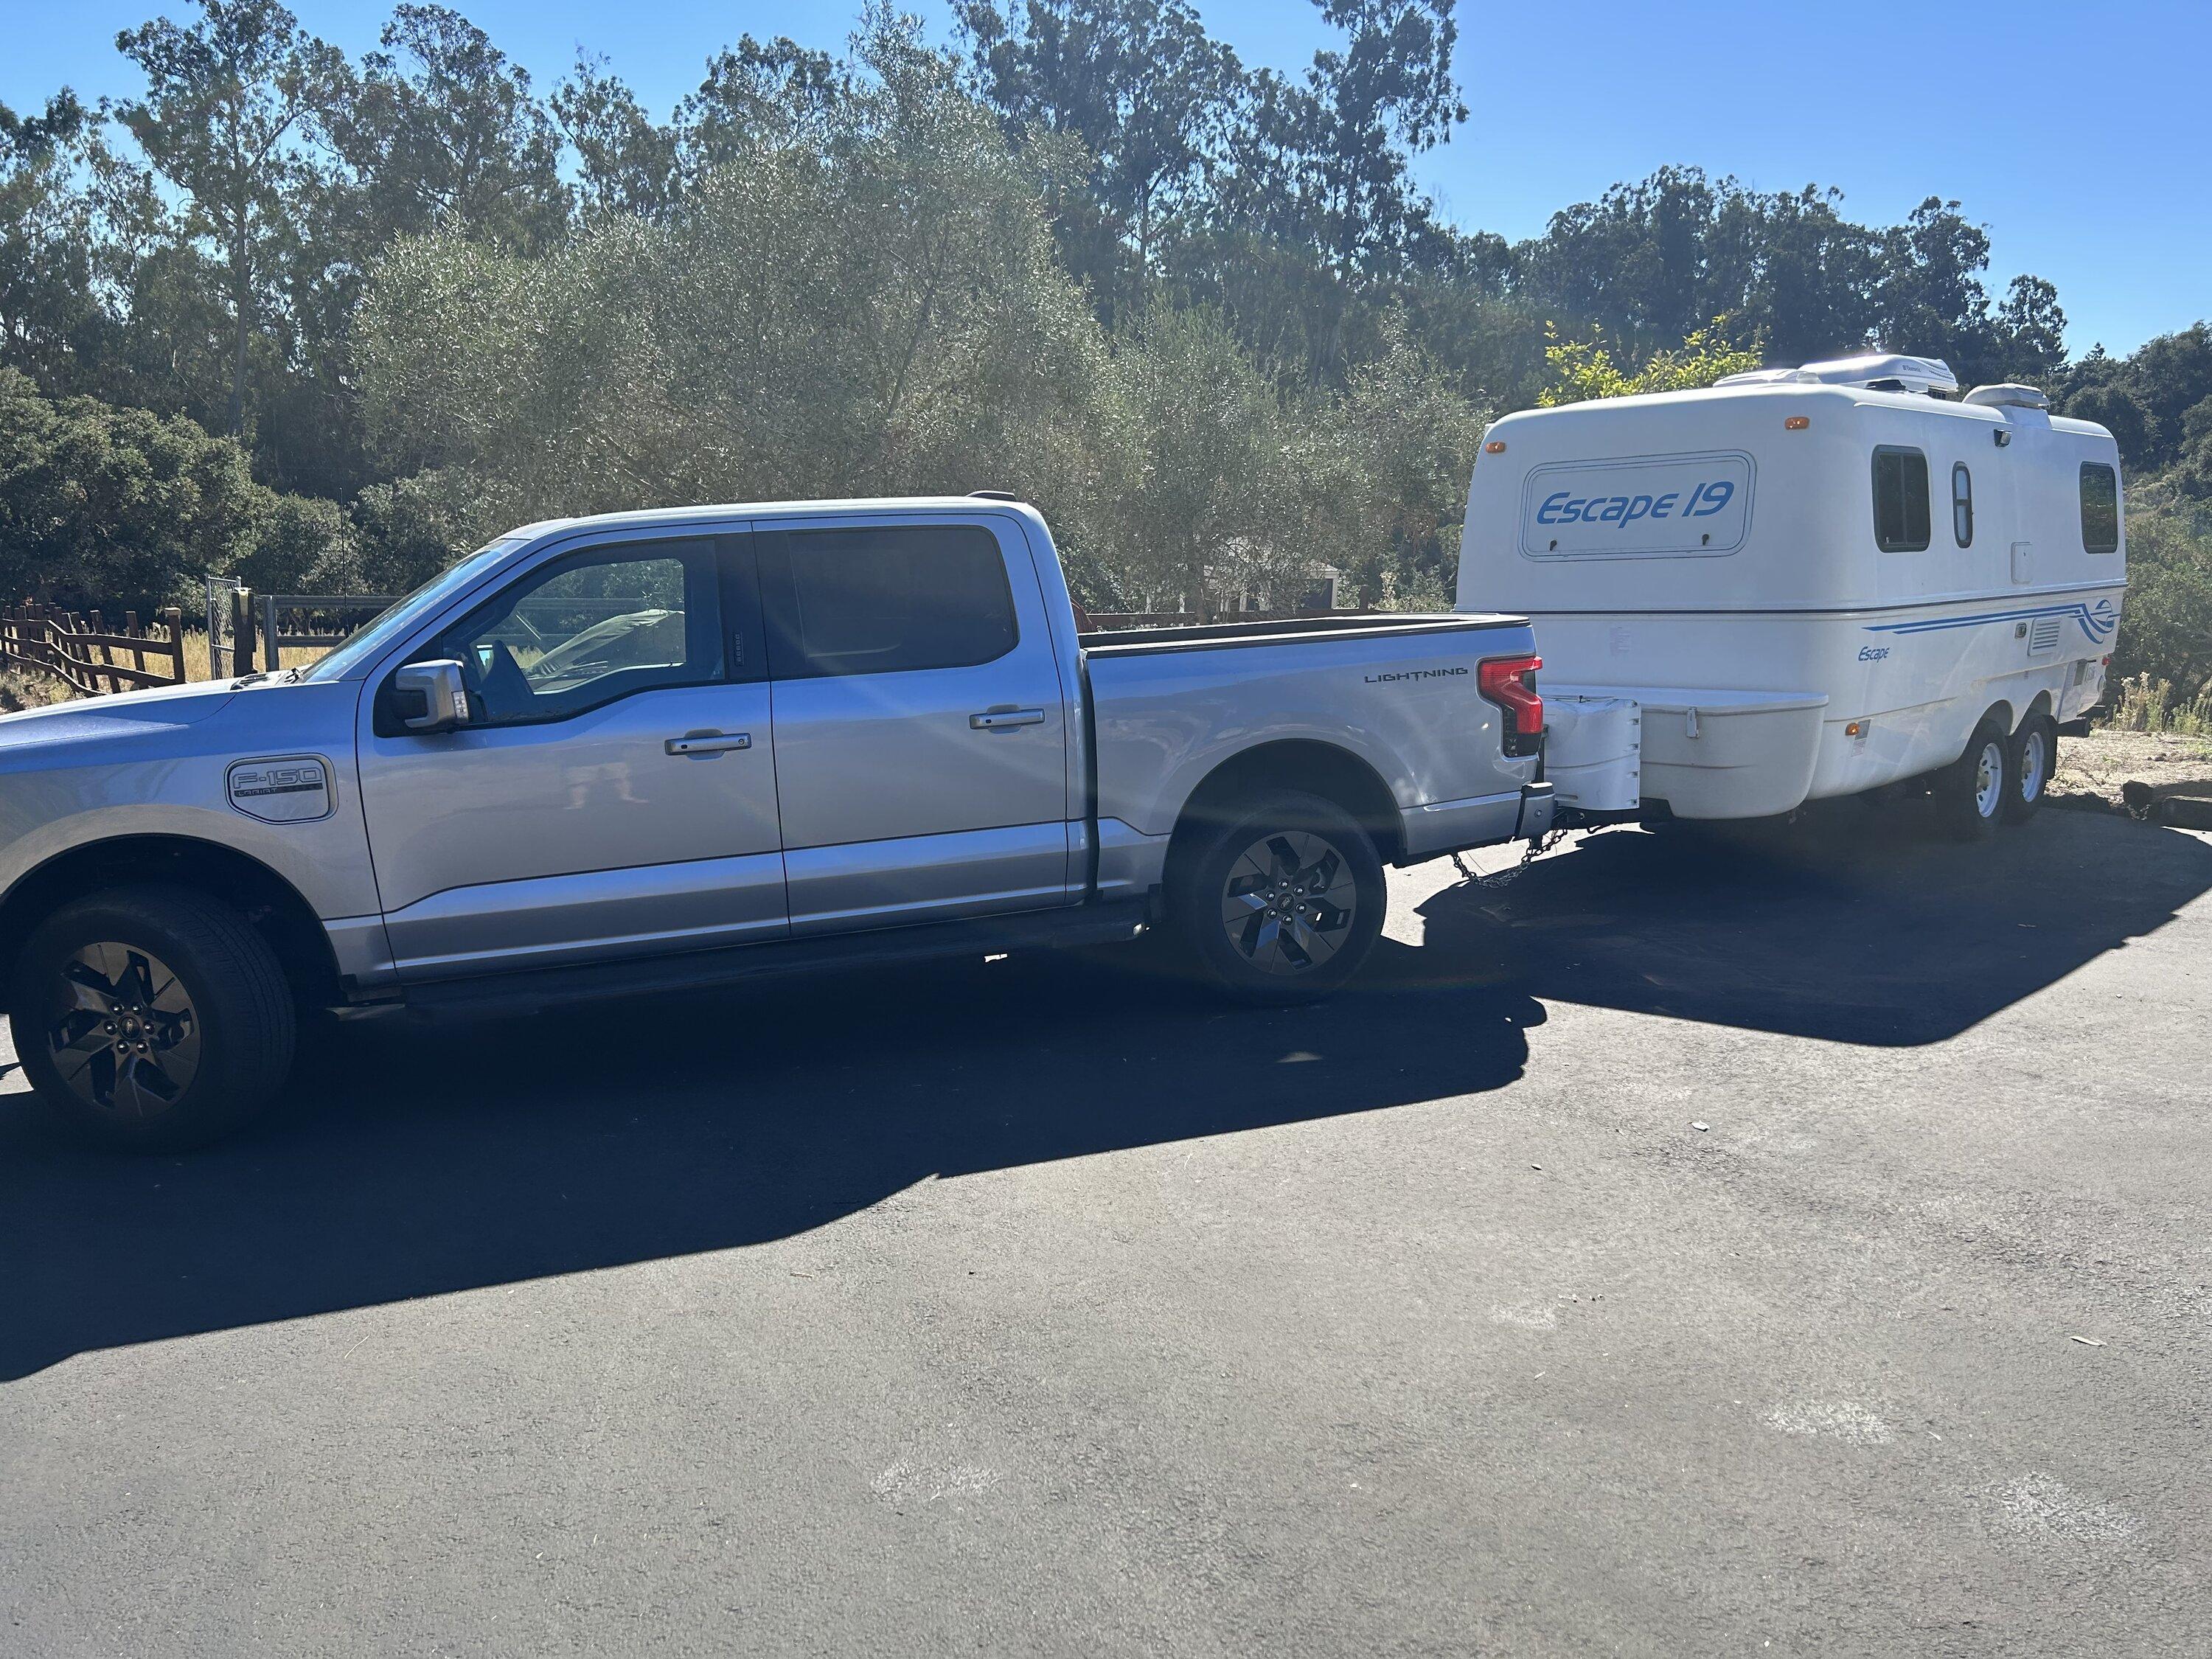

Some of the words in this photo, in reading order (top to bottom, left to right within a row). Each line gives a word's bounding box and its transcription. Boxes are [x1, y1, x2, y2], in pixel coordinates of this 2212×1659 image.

[1537, 491, 1680, 529] Escape
[1681, 481, 1734, 517] 19
[1858, 646, 1890, 663] Escape
[1364, 667, 1468, 683] LIGHTNING
[232, 767, 322, 789] F-150
[237, 787, 277, 796] LARIAT
